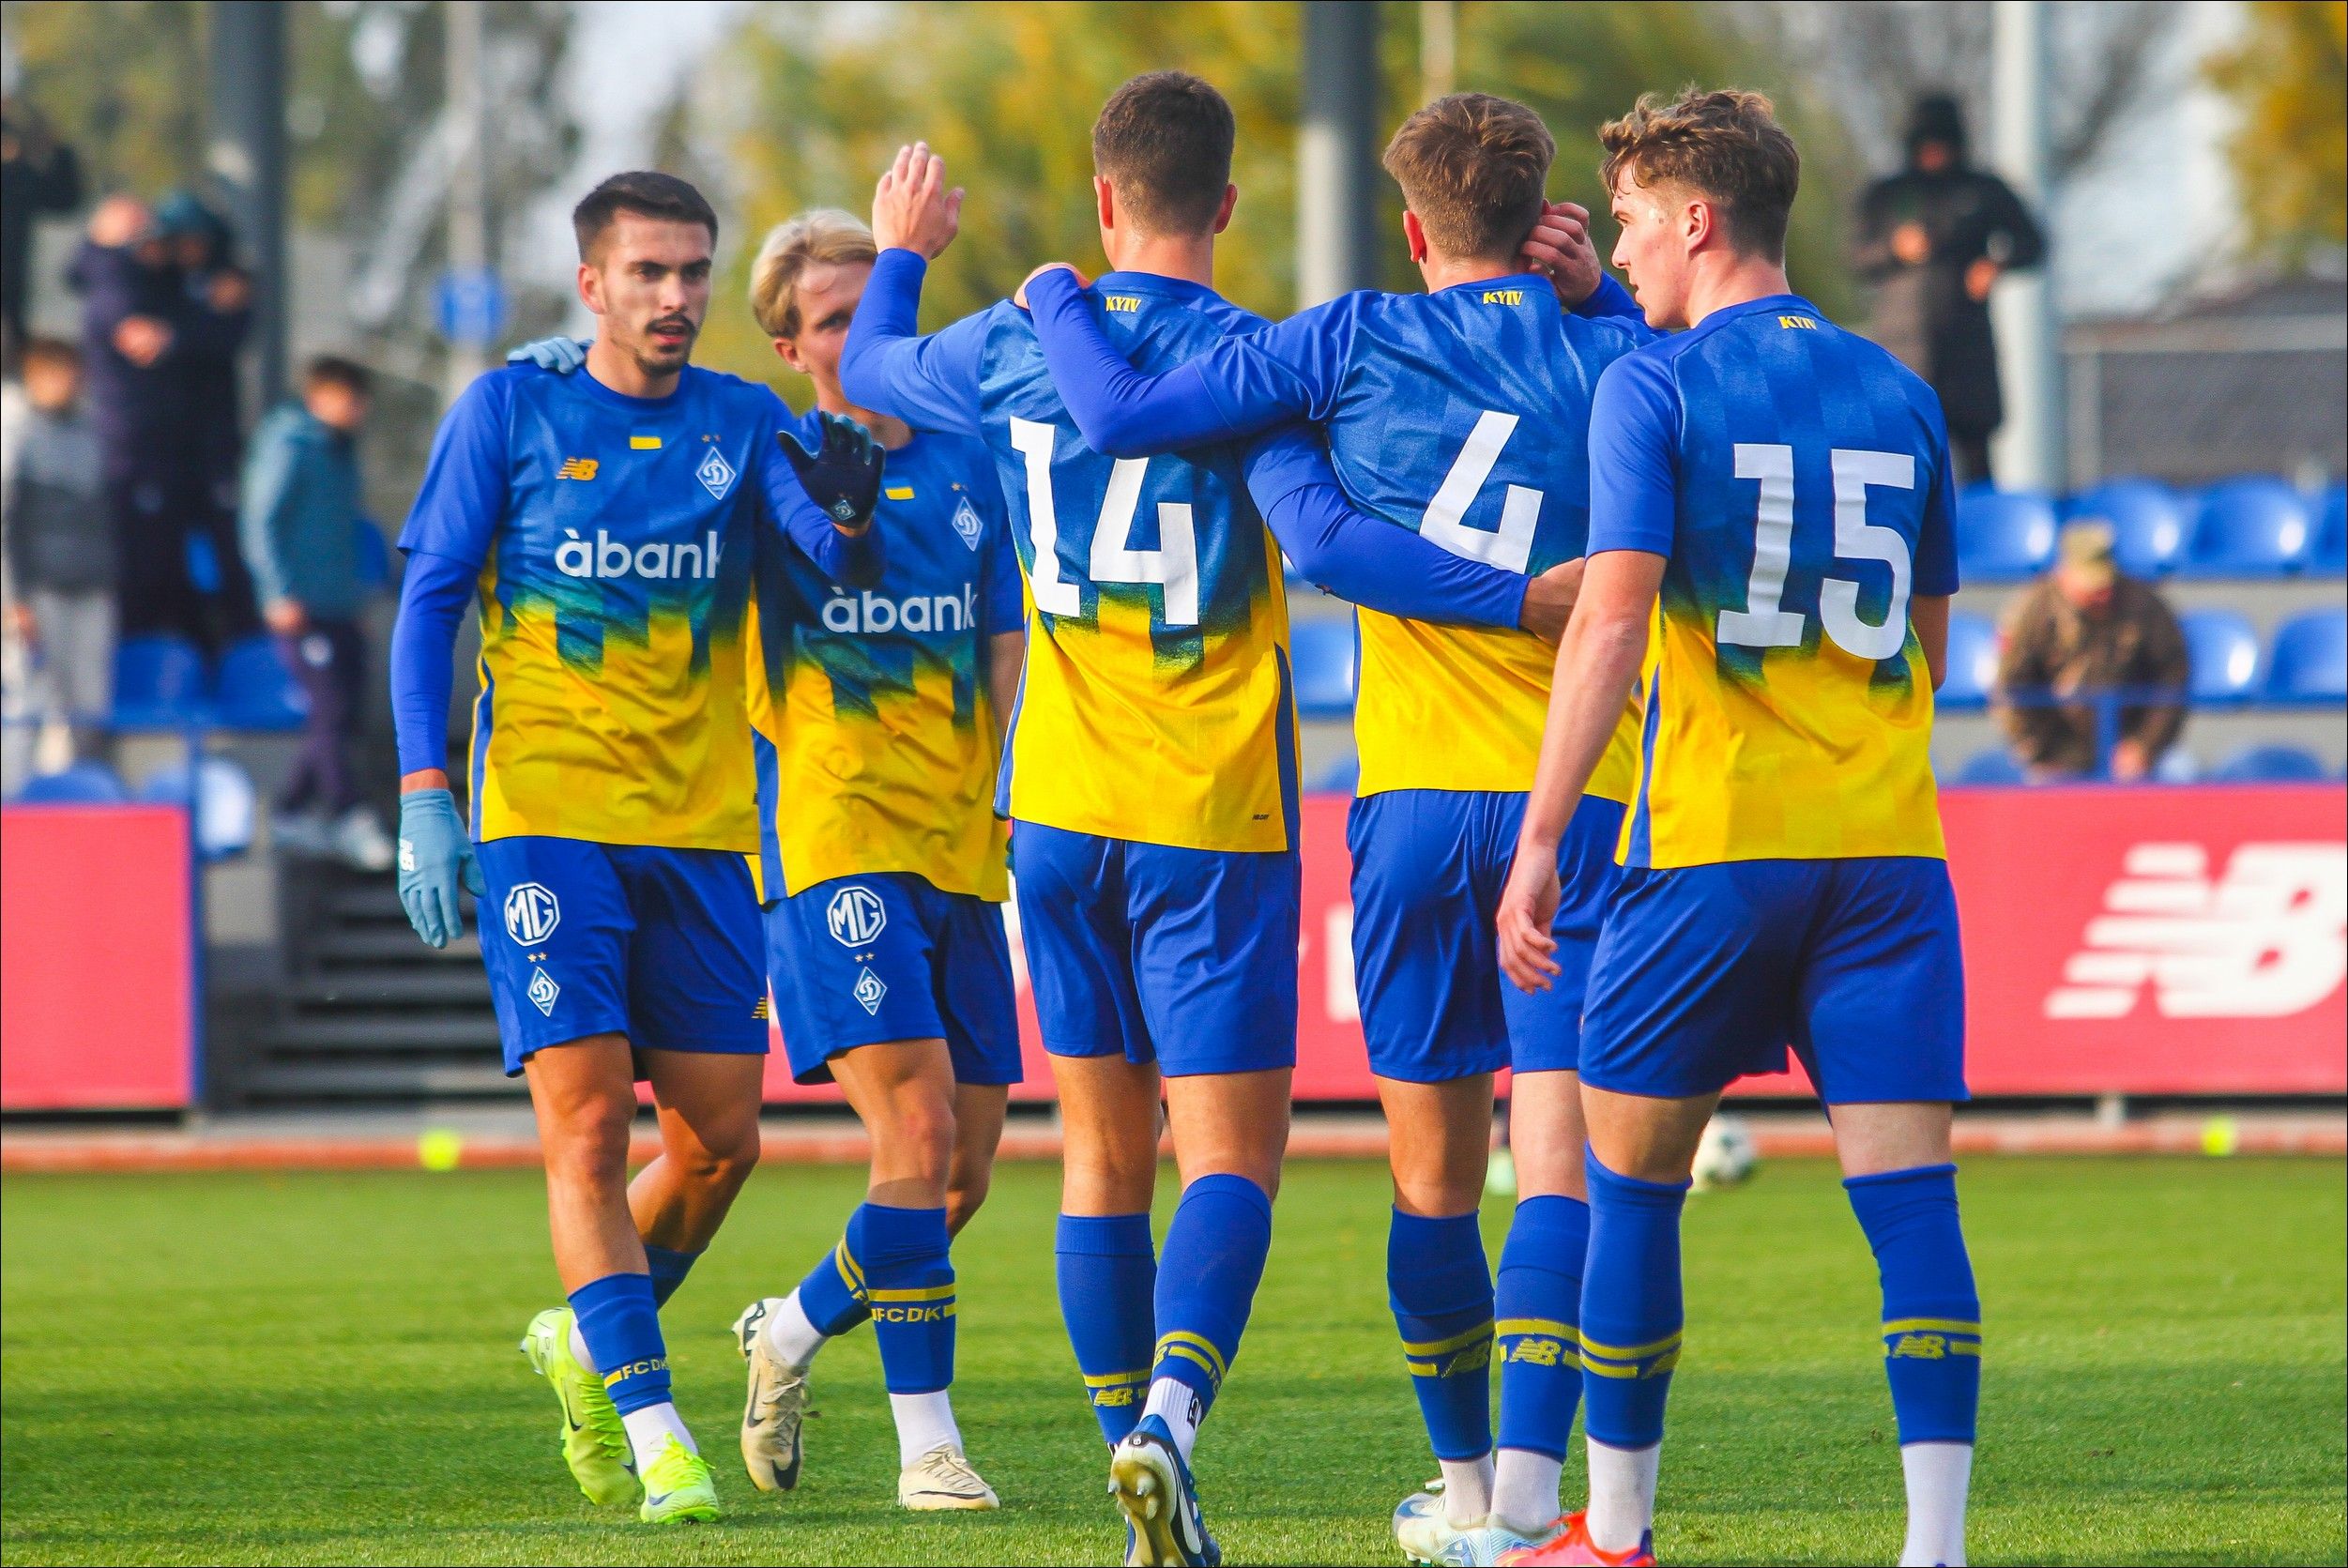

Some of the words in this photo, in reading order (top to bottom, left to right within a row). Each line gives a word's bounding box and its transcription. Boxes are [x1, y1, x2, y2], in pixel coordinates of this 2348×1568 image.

[1105, 296, 1142, 313] KYIV
[1483, 290, 1523, 306] KYIV
[1419, 410, 1543, 574] 4
[1010, 416, 1198, 625] 14
[1716, 443, 1915, 660] 15
[822, 583, 978, 633] àbank
[508, 888, 556, 940] MG
[832, 891, 881, 942] MG
